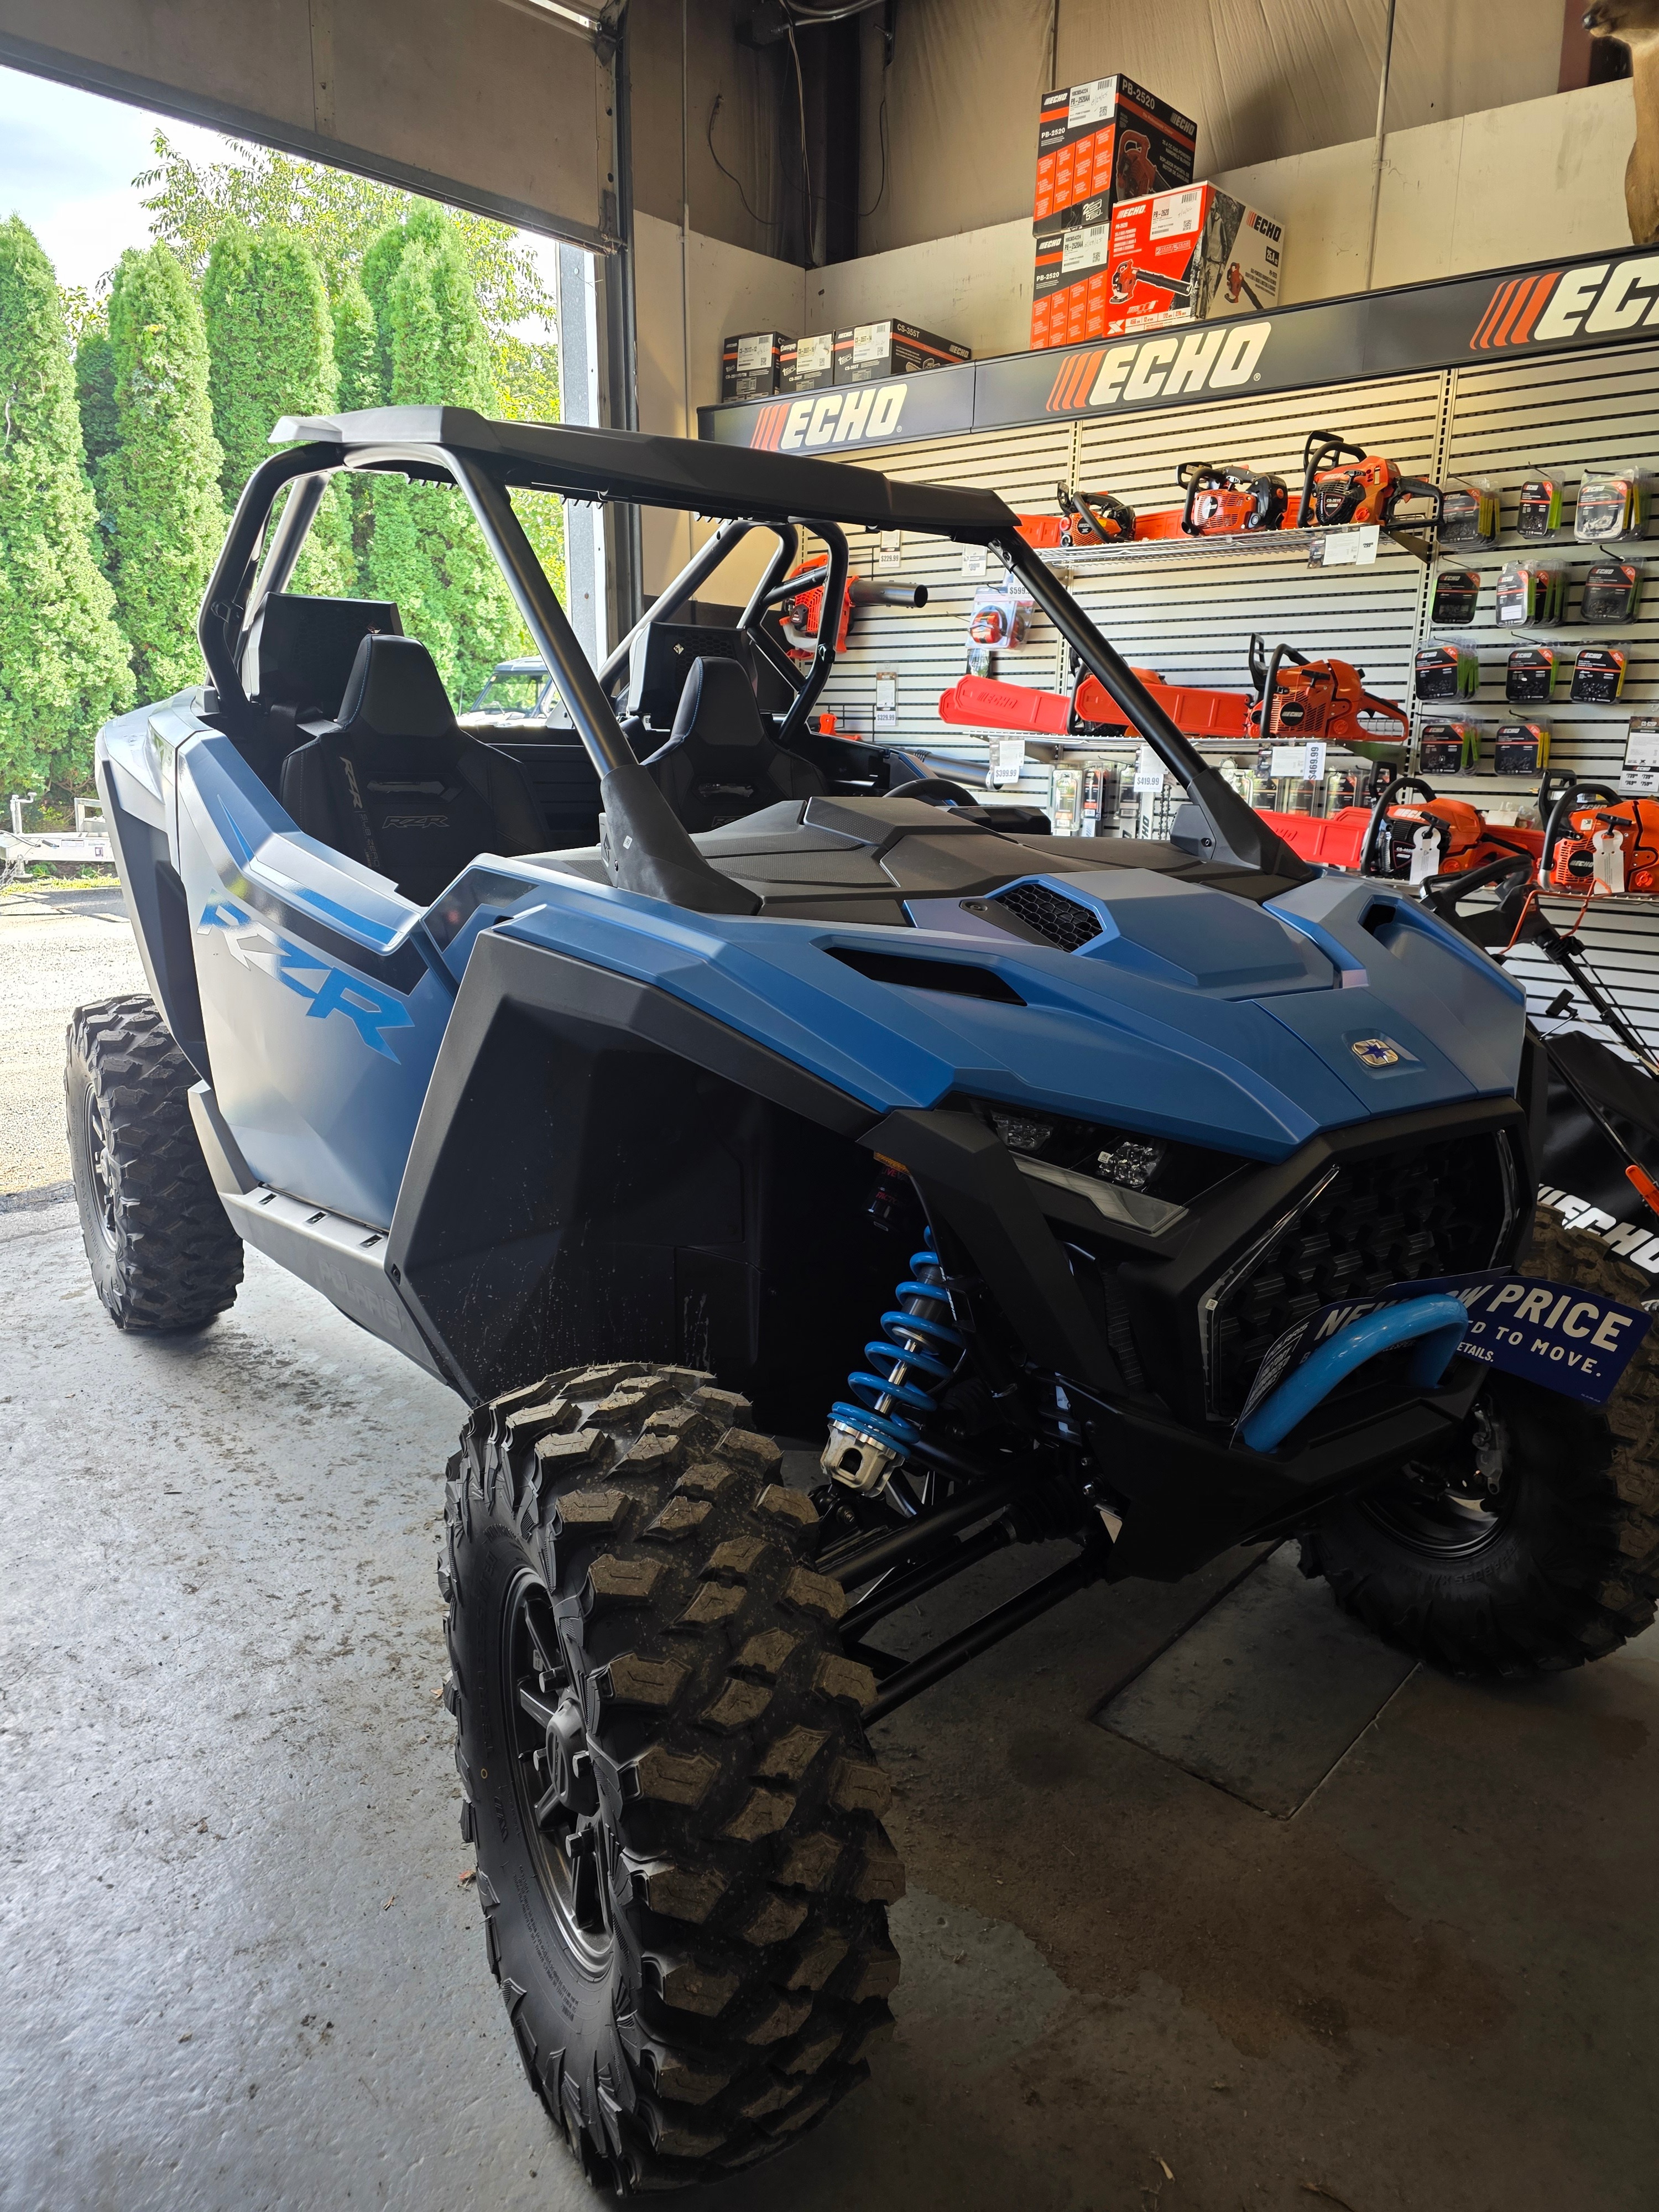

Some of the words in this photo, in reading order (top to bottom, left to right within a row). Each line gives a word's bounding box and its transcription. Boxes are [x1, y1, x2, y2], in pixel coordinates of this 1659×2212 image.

[1048, 93, 1067, 104] ECHO
[1122, 78, 1155, 109] PB-2520
[1041, 127, 1065, 138] PB-2520
[1174, 113, 1195, 136] ECHO
[1123, 205, 1146, 217] ECHO
[1254, 215, 1282, 243] ECHO
[1044, 238, 1061, 248] ECHO
[1036, 272, 1060, 281] PB-2520
[897, 324, 920, 338] CS-355T
[953, 346, 969, 358] ECHO
[1089, 322, 1271, 406] ECHO
[781, 384, 907, 450] ECHO
[995, 769, 1017, 777] $399.99
[1308, 747, 1319, 780] $469.99
[339, 756, 363, 810] RZR
[1137, 776, 1160, 785] $419.99
[382, 815, 451, 830] RZR
[197, 888, 415, 1065] RZR
[1486, 1284, 1633, 1352] PRICE
[1495, 1326, 1524, 1345] TO
[1530, 1339, 1601, 1377] MOVE.
